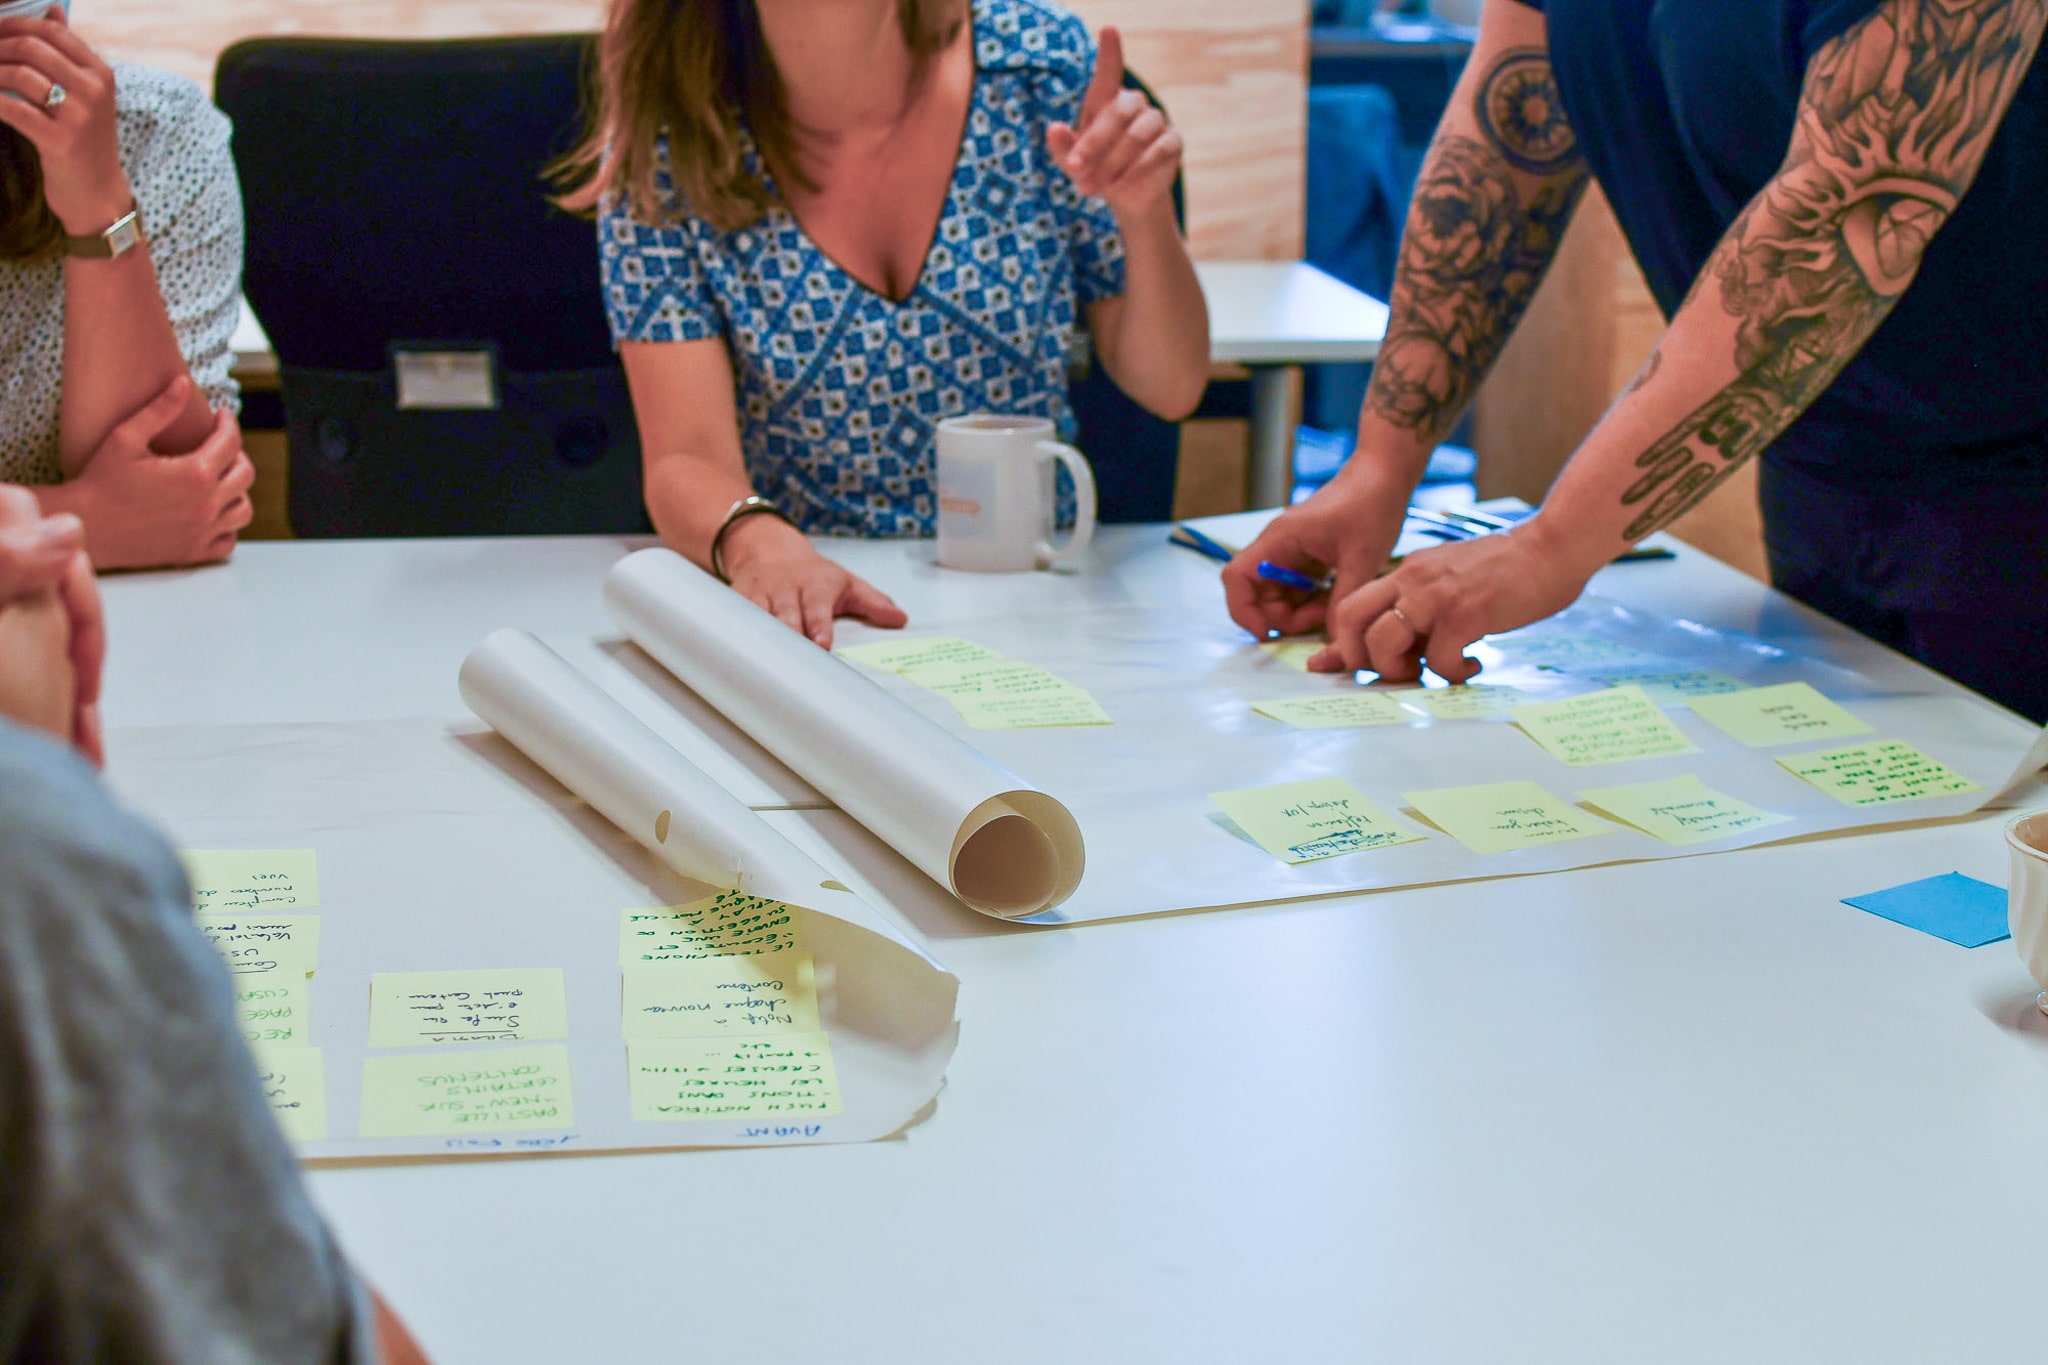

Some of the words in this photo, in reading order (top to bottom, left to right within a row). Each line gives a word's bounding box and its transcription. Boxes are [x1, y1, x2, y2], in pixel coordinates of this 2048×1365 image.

[246, 1006, 292, 1020] PAGE
[723, 1064, 821, 1073] CREUSES
[682, 1079, 766, 1087] HEURES
[676, 1091, 724, 1099] DANS
[766, 1102, 826, 1111] PUSH
[737, 1124, 821, 1137] AVANT
